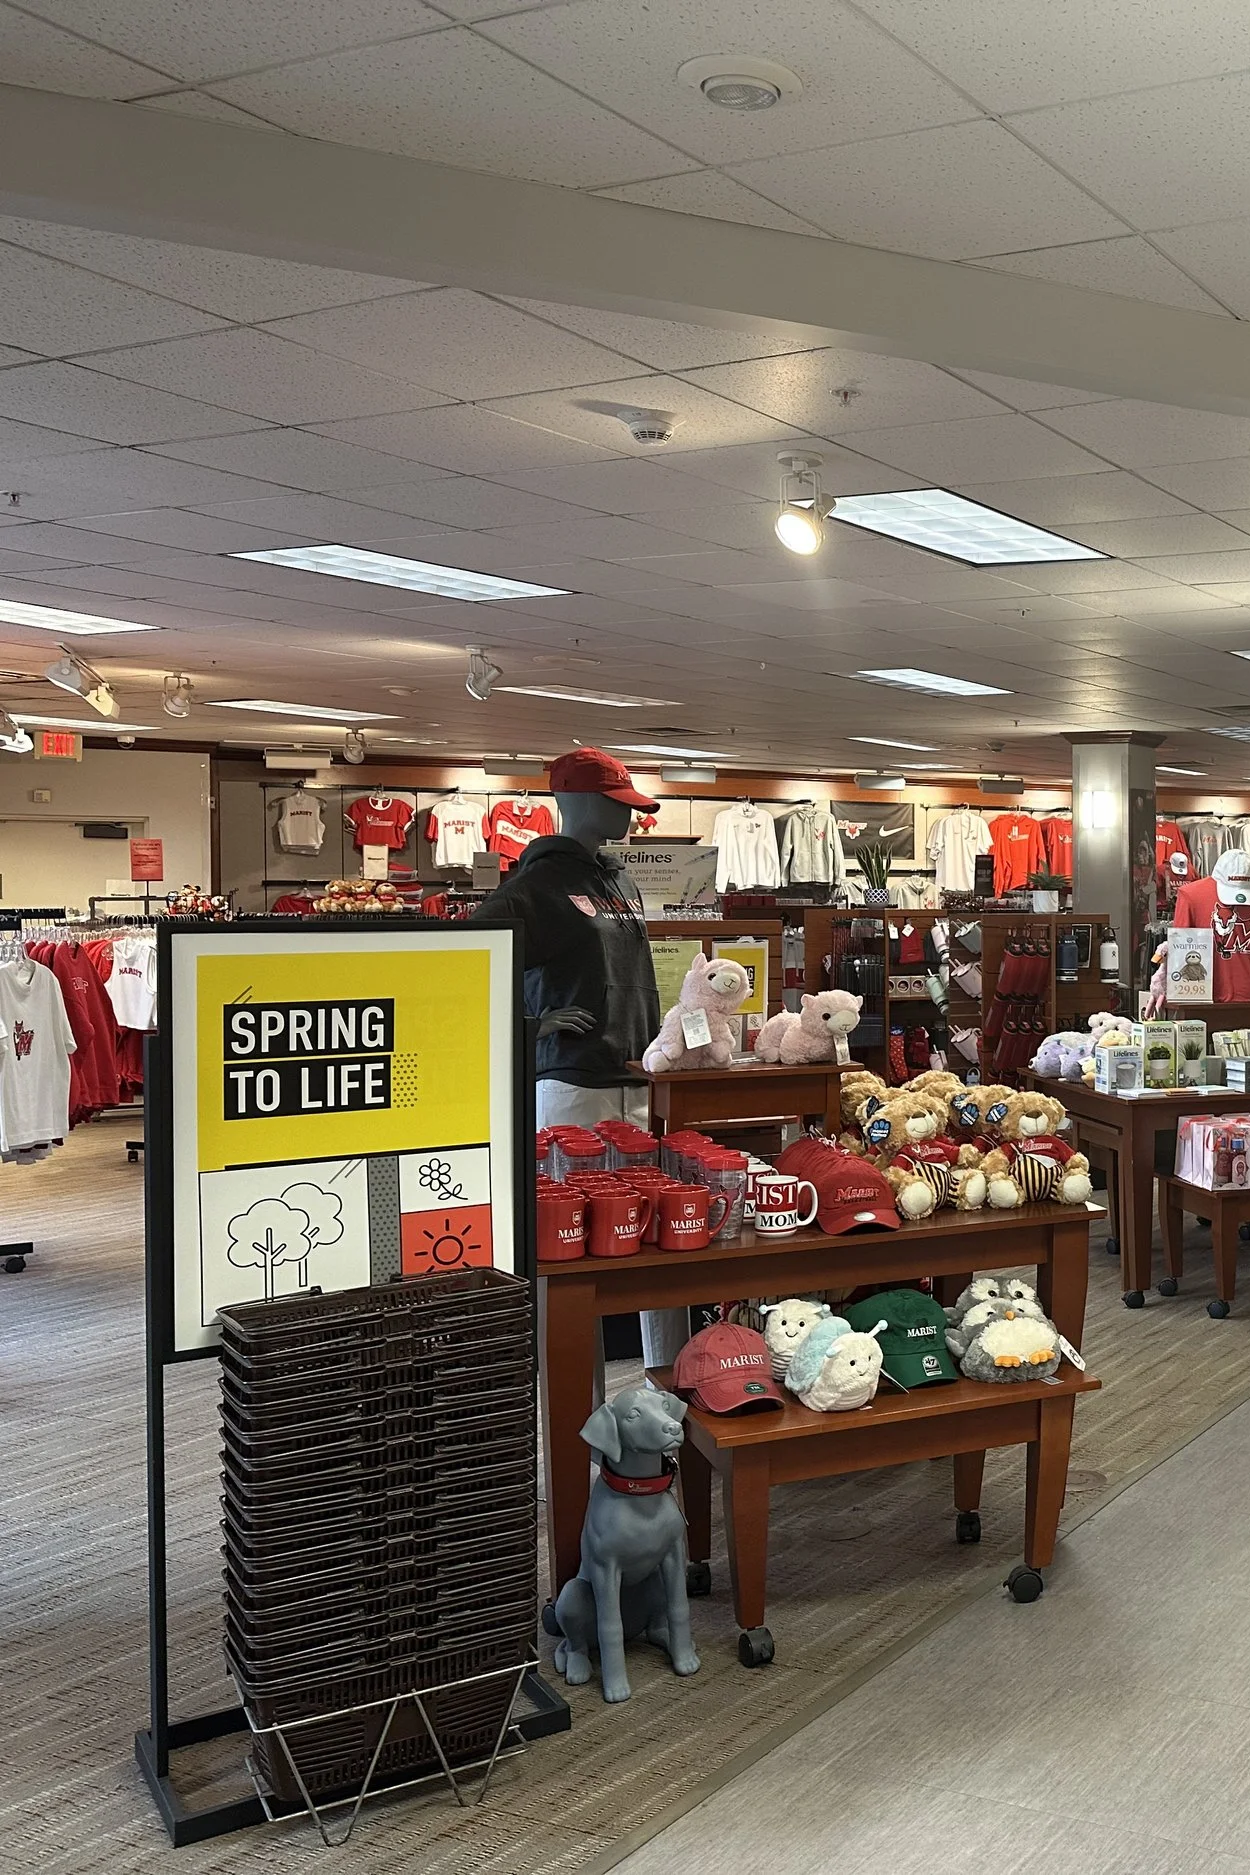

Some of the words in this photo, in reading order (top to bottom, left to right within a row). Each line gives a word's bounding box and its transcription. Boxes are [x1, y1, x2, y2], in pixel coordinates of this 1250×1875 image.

[43, 732, 75, 756] EXIT
[444, 820, 475, 828] MARIST
[501, 825, 533, 840] MARIST
[620, 851, 672, 863] ifelines
[231, 1006, 385, 1055] SPRING
[229, 1068, 281, 1113] TO
[301, 1062, 385, 1109] LIFE
[755, 1184, 797, 1206] RIST
[670, 1217, 705, 1230] MARIST
[760, 1213, 797, 1228] MOM
[558, 1226, 584, 1240] MARIS
[613, 1223, 639, 1235] MARIS
[906, 1325, 938, 1338] MARIST
[719, 1354, 765, 1370] MARIST
